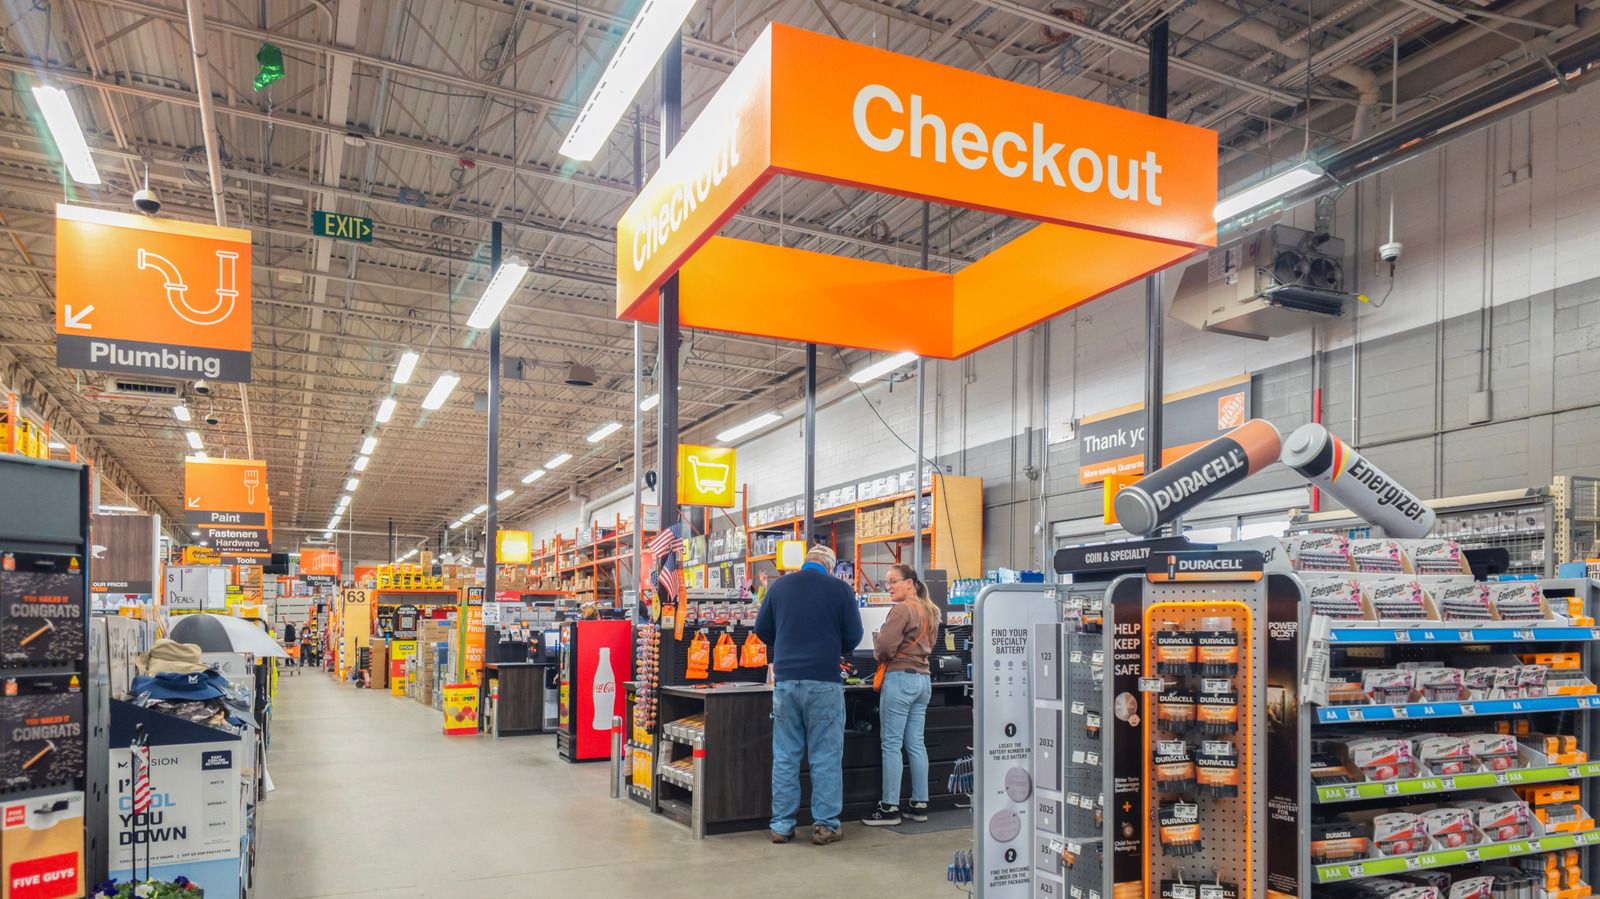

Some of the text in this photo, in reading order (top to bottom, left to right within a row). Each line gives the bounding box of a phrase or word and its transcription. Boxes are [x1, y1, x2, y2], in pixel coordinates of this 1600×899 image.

[853, 84, 1162, 206] Checkout
[633, 115, 740, 272] Checkout
[325, 214, 364, 239] EXIT
[90, 341, 221, 379] Plumbing
[1218, 393, 1244, 428] HOME
[1084, 427, 1145, 453] Thank yo
[1084, 460, 1145, 478] More saving. Guarante
[1152, 450, 1244, 512] DURACELL
[1347, 457, 1426, 521] Energizer
[211, 512, 240, 523] Paint
[209, 529, 258, 539] Fasteners
[216, 539, 260, 548] Hardware
[1300, 537, 1333, 551] Energizer
[1353, 542, 1382, 555] Energizer
[1416, 542, 1444, 557] Energizer
[1085, 547, 1150, 564] COIN & SPECIALTY
[1179, 559, 1242, 571] DURACELL
[168, 573, 175, 583] $
[469, 588, 482, 596] GET
[1310, 582, 1344, 598] Energizer
[1374, 584, 1405, 599] Energizer
[1443, 585, 1475, 599] Energizer
[1497, 585, 1526, 601] Energizer
[347, 590, 365, 603] 63
[10, 604, 80, 618] CONGRATS
[1114, 623, 1141, 635] HELP
[1268, 622, 1298, 630] POWER
[991, 629, 1028, 637] FIND YOUR
[1270, 629, 1296, 638] BOOST
[1424, 632, 1435, 640] AA
[991, 637, 1028, 646] SPECIALTY
[1114, 638, 1140, 650] KEEP
[466, 646, 483, 654] Save
[995, 646, 1026, 655] BATTERY
[466, 654, 481, 662] $100
[1041, 652, 1052, 661] 123
[1114, 664, 1140, 676] SAFE
[1199, 696, 1235, 704] DURACELL
[1424, 706, 1435, 715] AA
[1513, 702, 1522, 710] AA
[1327, 711, 1338, 719] AA
[12, 723, 80, 742] CONGRATS
[1008, 725, 1013, 735] 1
[1039, 737, 1054, 748] 2032
[1155, 754, 1190, 763] DURACELL
[1198, 759, 1235, 767] DURACELL
[1509, 773, 1523, 781] AAA
[1422, 781, 1437, 789] AAA
[1326, 789, 1342, 798] AAA
[118, 793, 176, 811] COL
[1268, 802, 1298, 812] BRIGHTEST
[8, 809, 22, 817] FIVE
[1039, 804, 1054, 815] 2025
[7, 815, 25, 823] GUYS
[119, 811, 162, 828] YOU
[1161, 817, 1197, 825] DURACELL
[1271, 812, 1295, 823] LONGER
[119, 826, 187, 846] DOWN
[1587, 833, 1600, 841] AAA
[1509, 845, 1523, 853] AAA
[1008, 851, 1014, 861] 2
[1422, 855, 1437, 864] AAA
[13, 867, 75, 889] FIVE GUYS
[1326, 868, 1342, 878] AAA
[1040, 883, 1053, 894] A23
